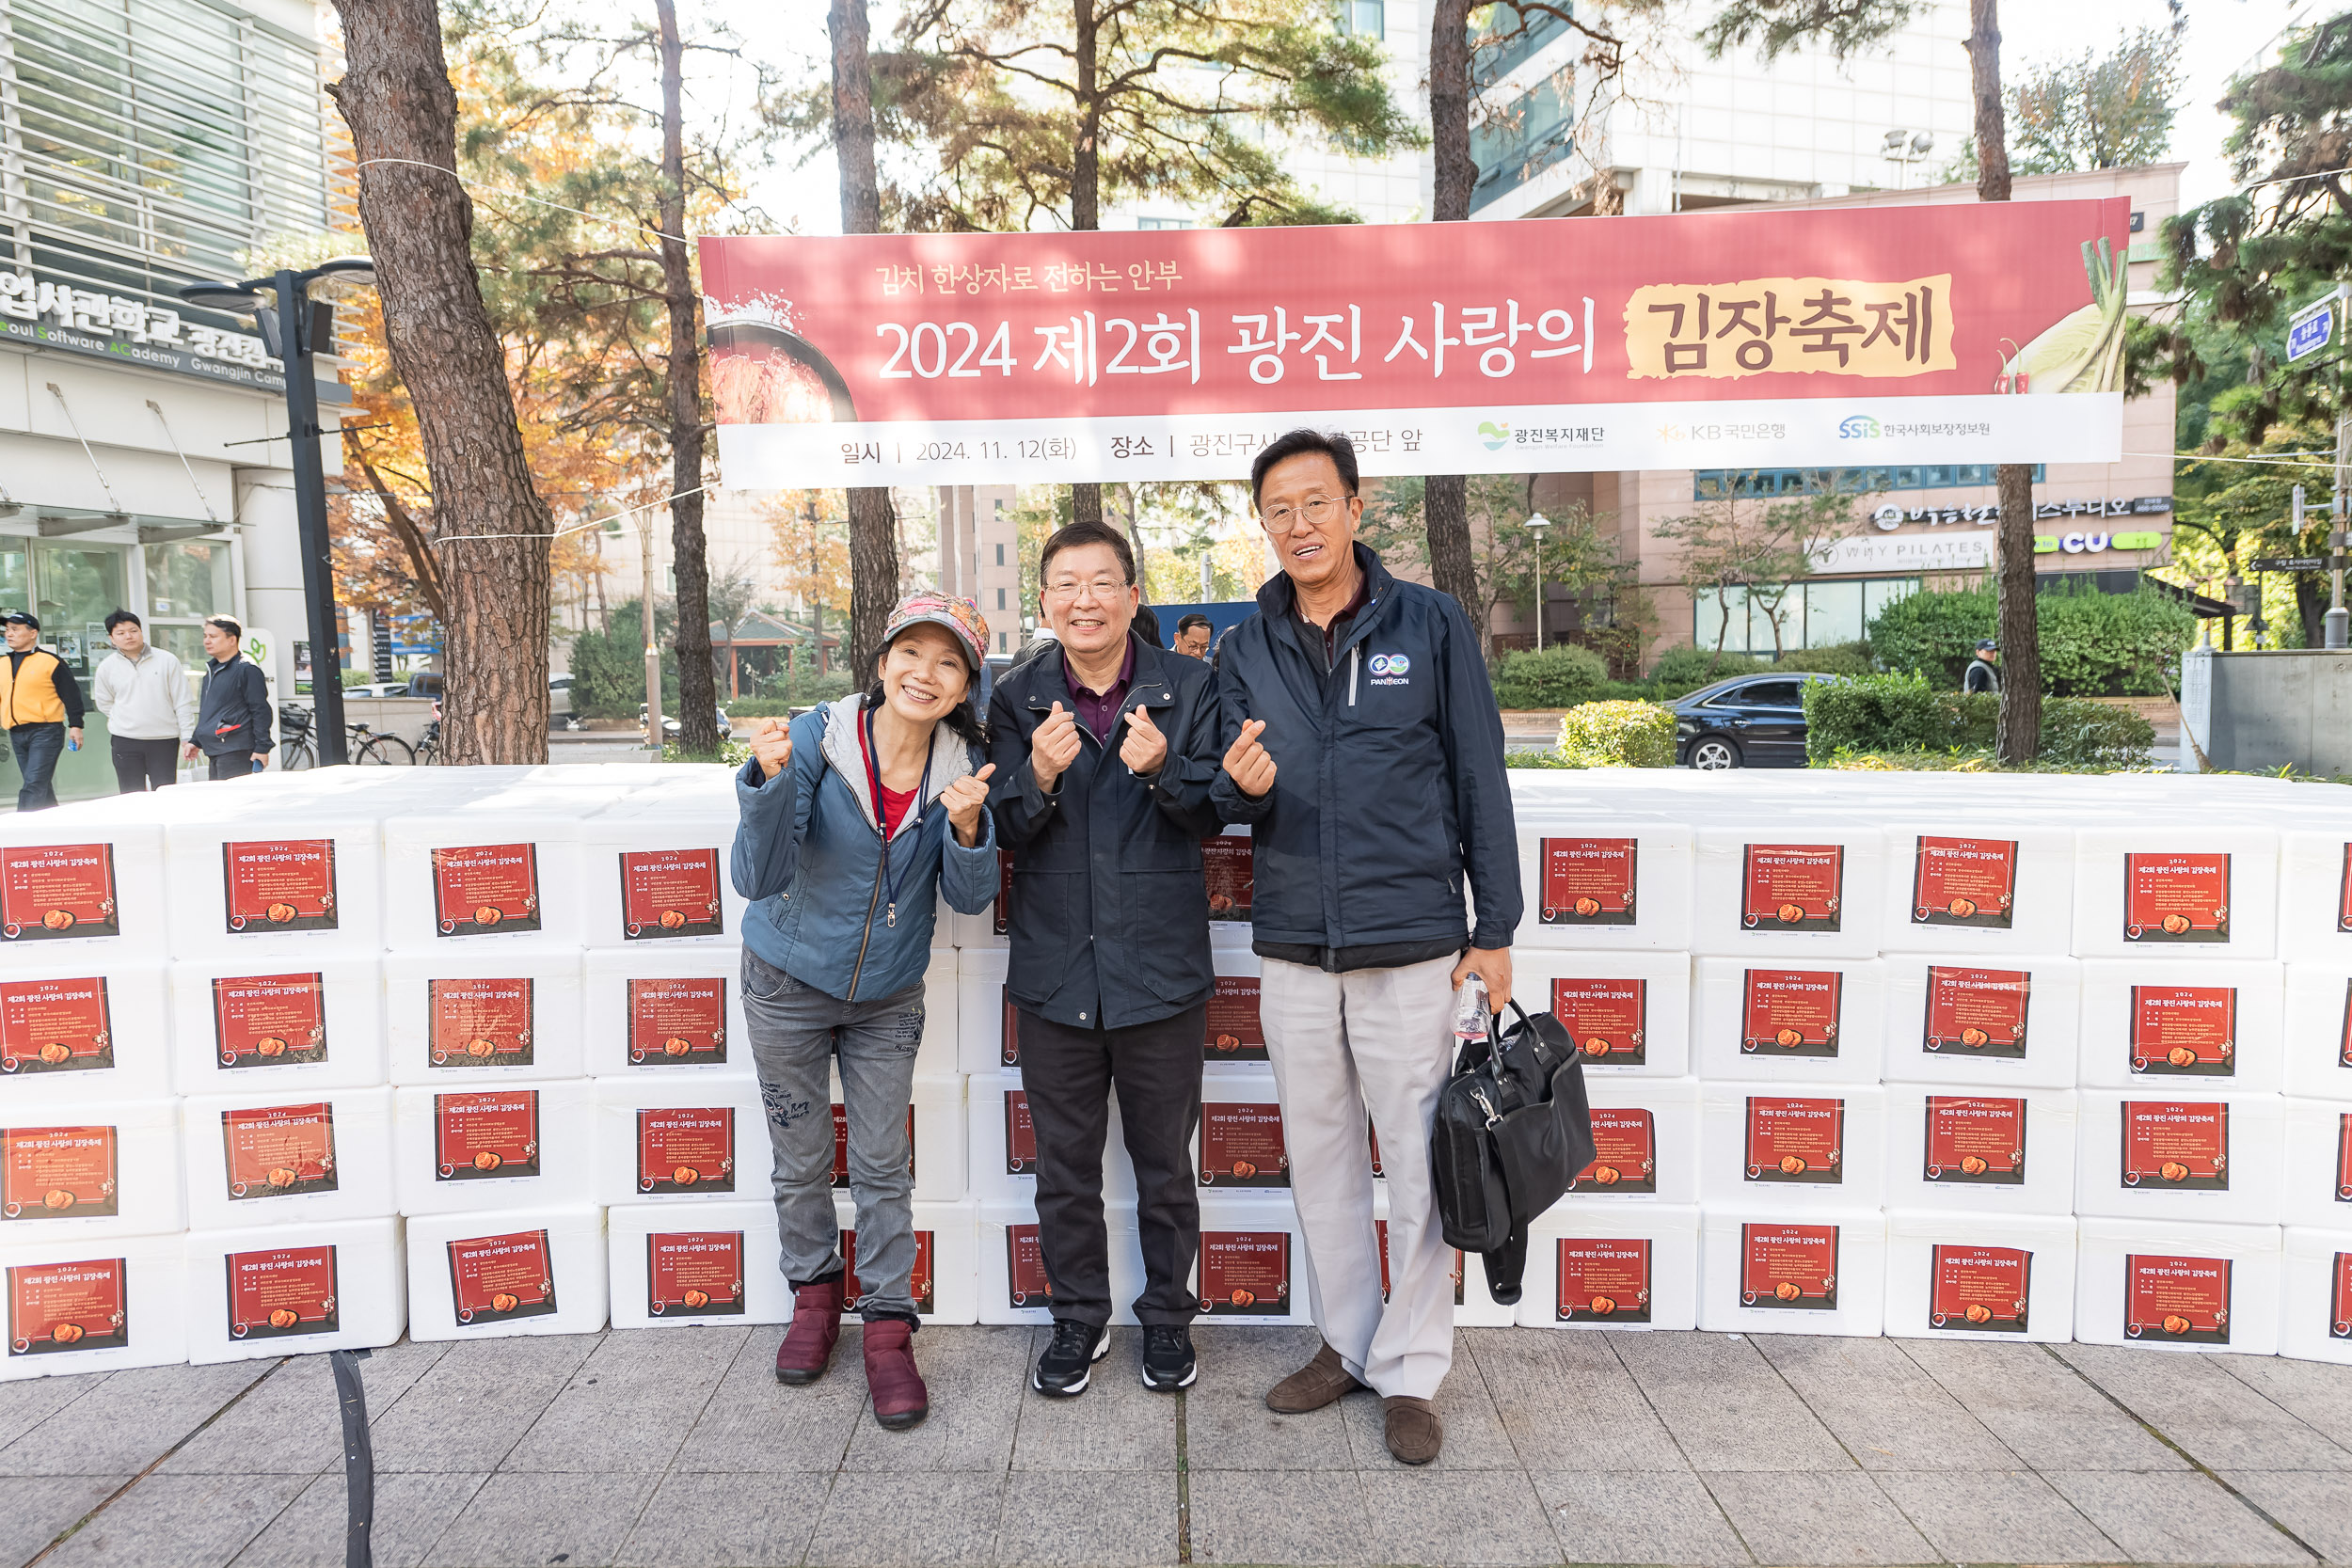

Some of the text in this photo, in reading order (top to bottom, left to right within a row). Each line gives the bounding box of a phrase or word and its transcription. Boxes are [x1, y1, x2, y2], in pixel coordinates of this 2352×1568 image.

[876, 260, 1183, 296] 김치 한상자로 전하는 안부
[876, 285, 1933, 388] 2024 제2회 광진 사랑의 김장축제
[38, 326, 105, 351] Software
[110, 342, 181, 368] ACademy
[191, 358, 251, 381] Gwangjin
[1515, 427, 1604, 443] 광진복지재단
[1883, 422, 1991, 436] 한국사회보장정보원
[841, 442, 881, 464] 일시
[916, 441, 970, 461] 2024.
[980, 441, 1008, 460] 11.
[1017, 436, 1077, 461] 12(화)
[1110, 436, 1155, 459] 장소
[1401, 429, 1422, 451] 앞
[1897, 541, 1982, 555] PILATES
[2063, 531, 2108, 554] CU
[30, 859, 44, 868] 광진
[46, 858, 67, 867] 사랑의
[492, 1246, 509, 1254] 사랑의
[43, 1275, 57, 1283] 광진
[59, 1273, 80, 1282] 사랑의
